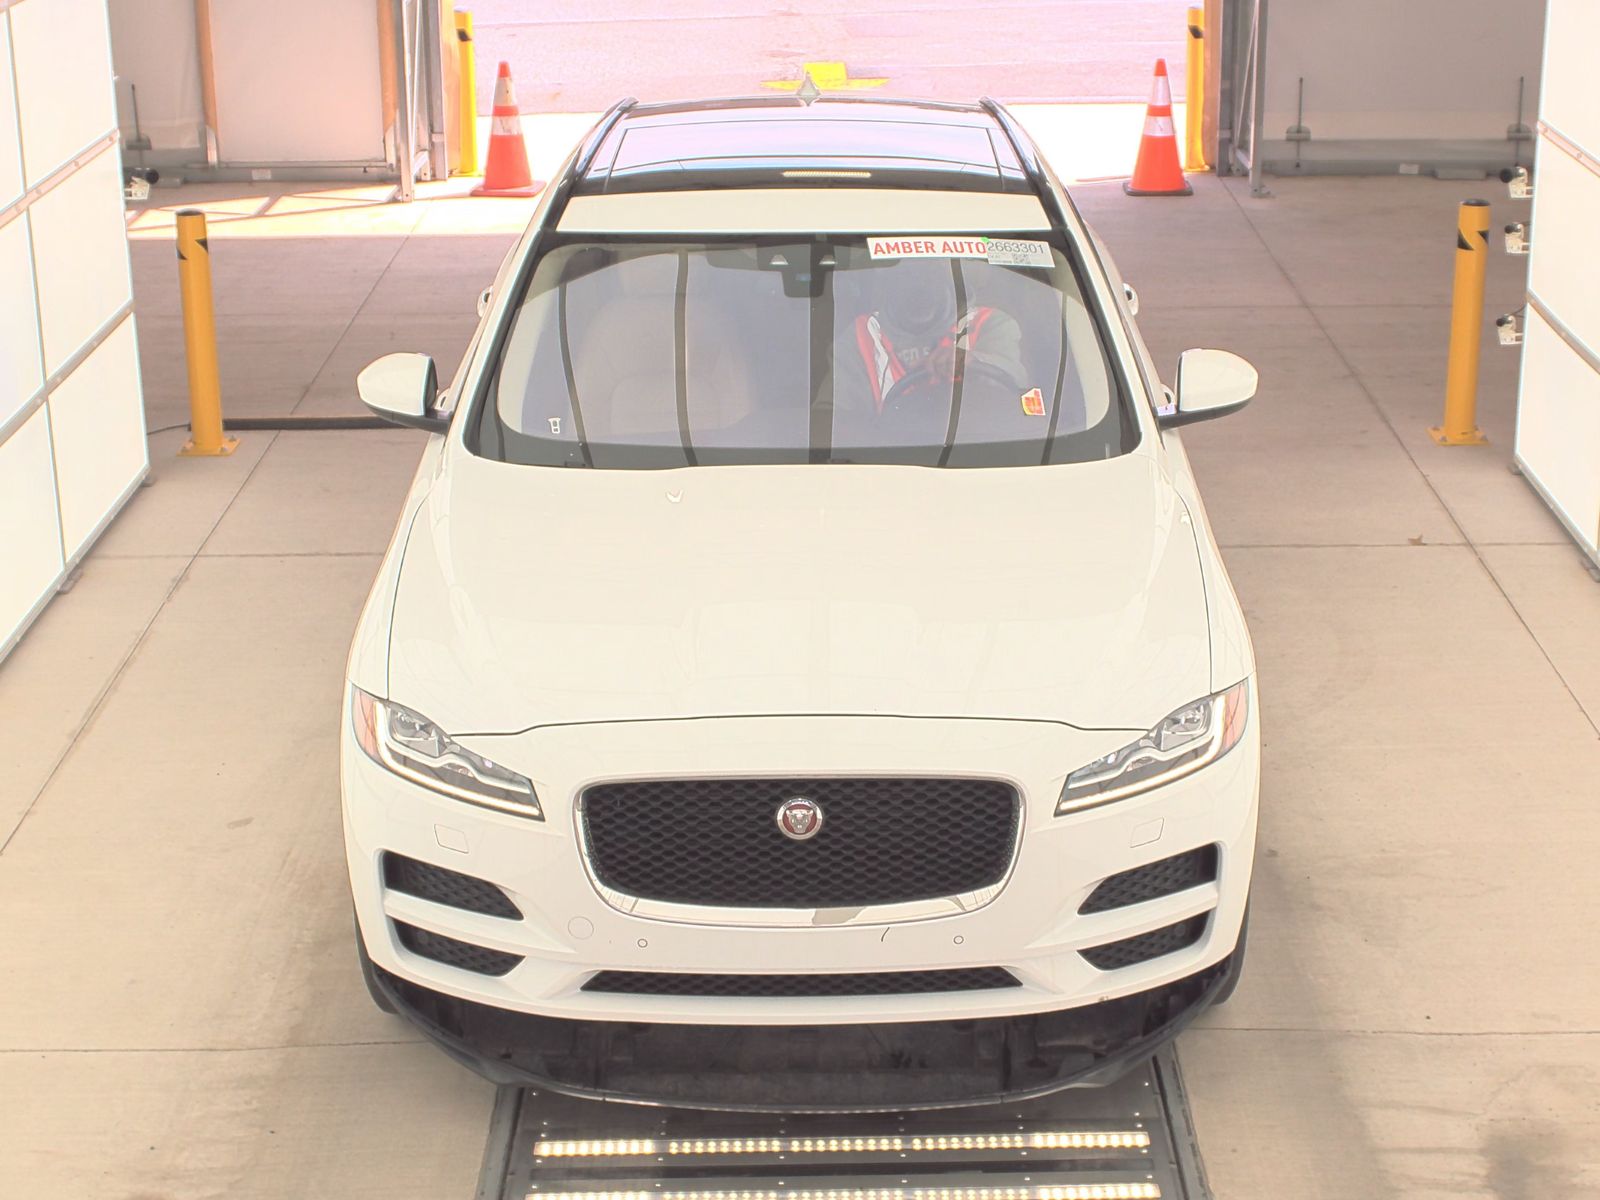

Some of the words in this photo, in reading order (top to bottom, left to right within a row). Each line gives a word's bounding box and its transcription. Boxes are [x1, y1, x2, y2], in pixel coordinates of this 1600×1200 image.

[873, 241, 935, 255] AMBER
[942, 241, 987, 254] AUTO
[987, 241, 1044, 254] 2663301
